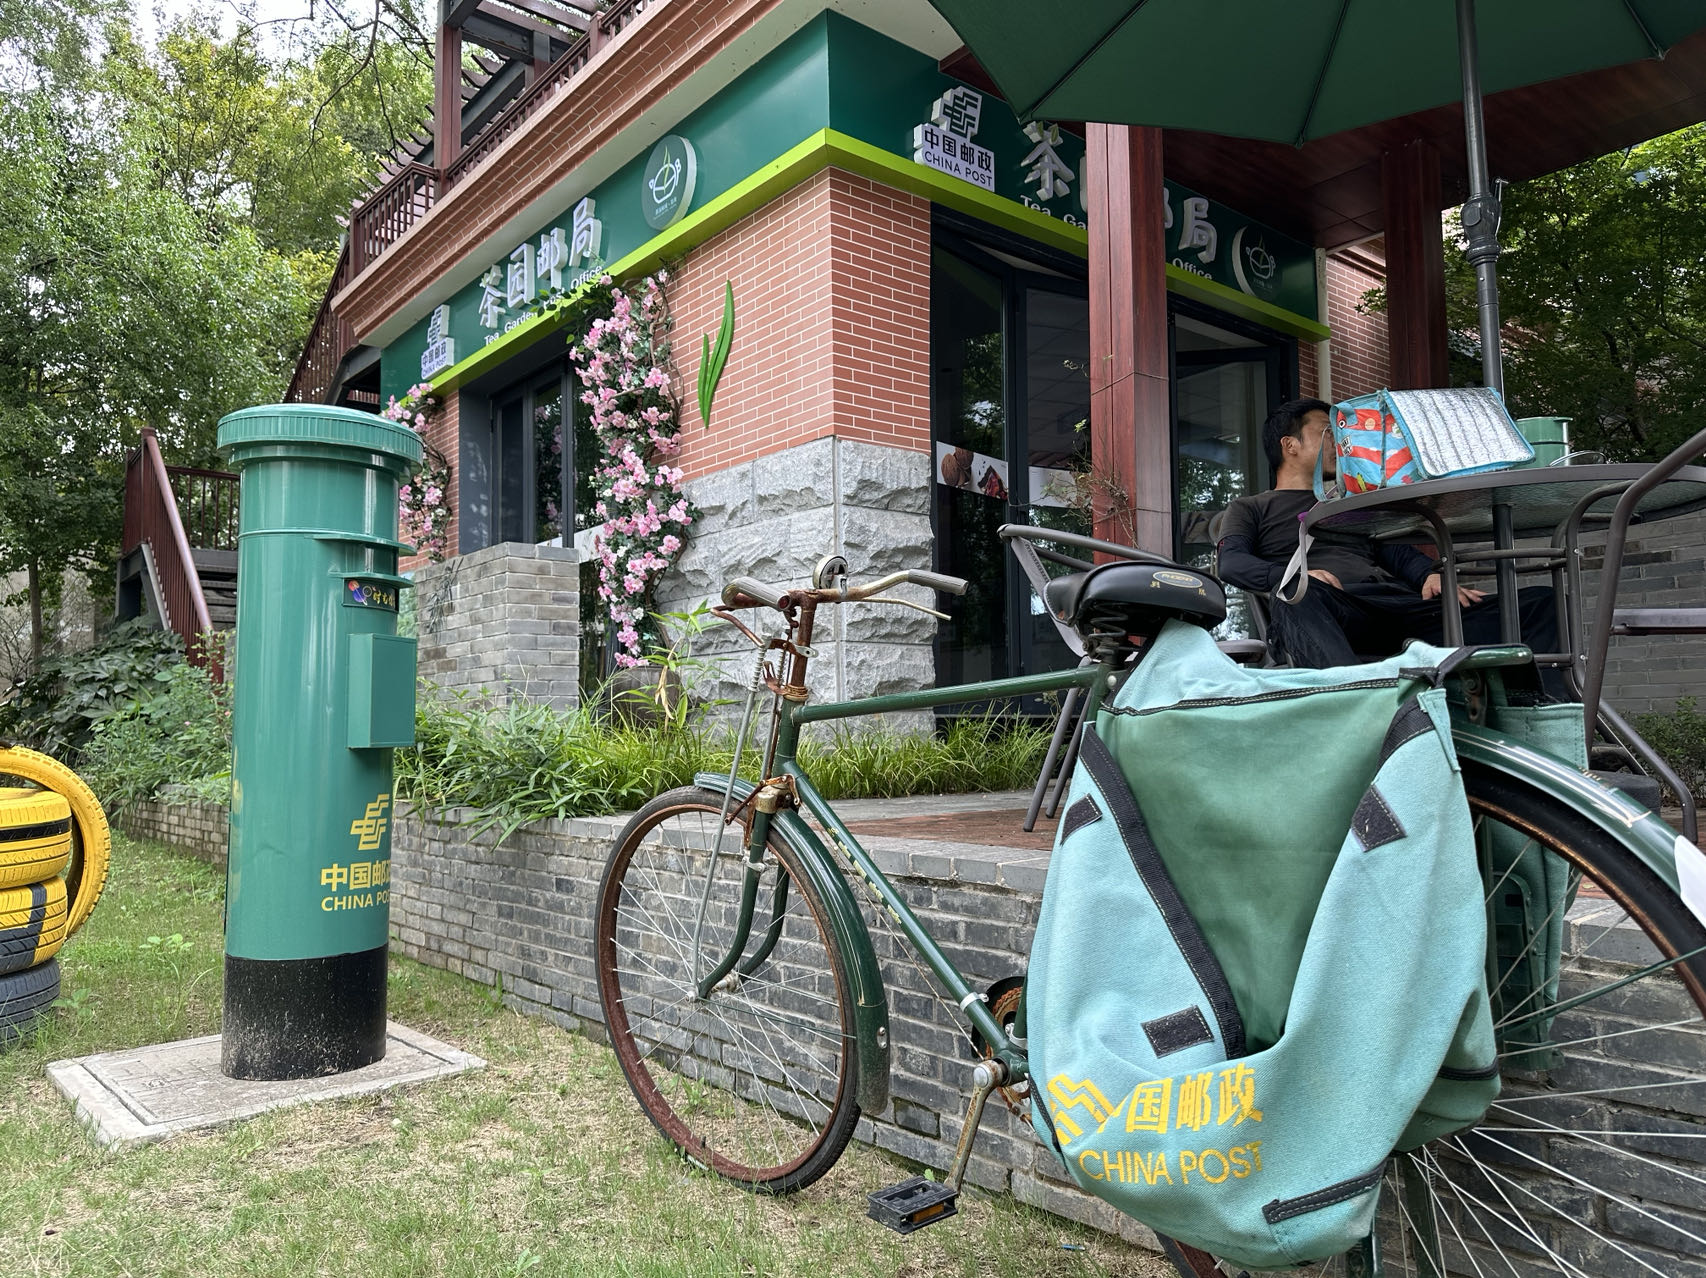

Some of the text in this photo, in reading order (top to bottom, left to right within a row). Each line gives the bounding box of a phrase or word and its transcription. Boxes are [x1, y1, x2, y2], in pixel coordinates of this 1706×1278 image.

[924, 128, 992, 173] 中国邮政
[924, 151, 993, 187] CHINA POST
[1020, 194, 1051, 217] Tea
[479, 197, 602, 328] 茶园邮局
[484, 332, 500, 347] Tea
[321, 893, 374, 912] CHINA
[1078, 1140, 1263, 1185] CHINA POST
